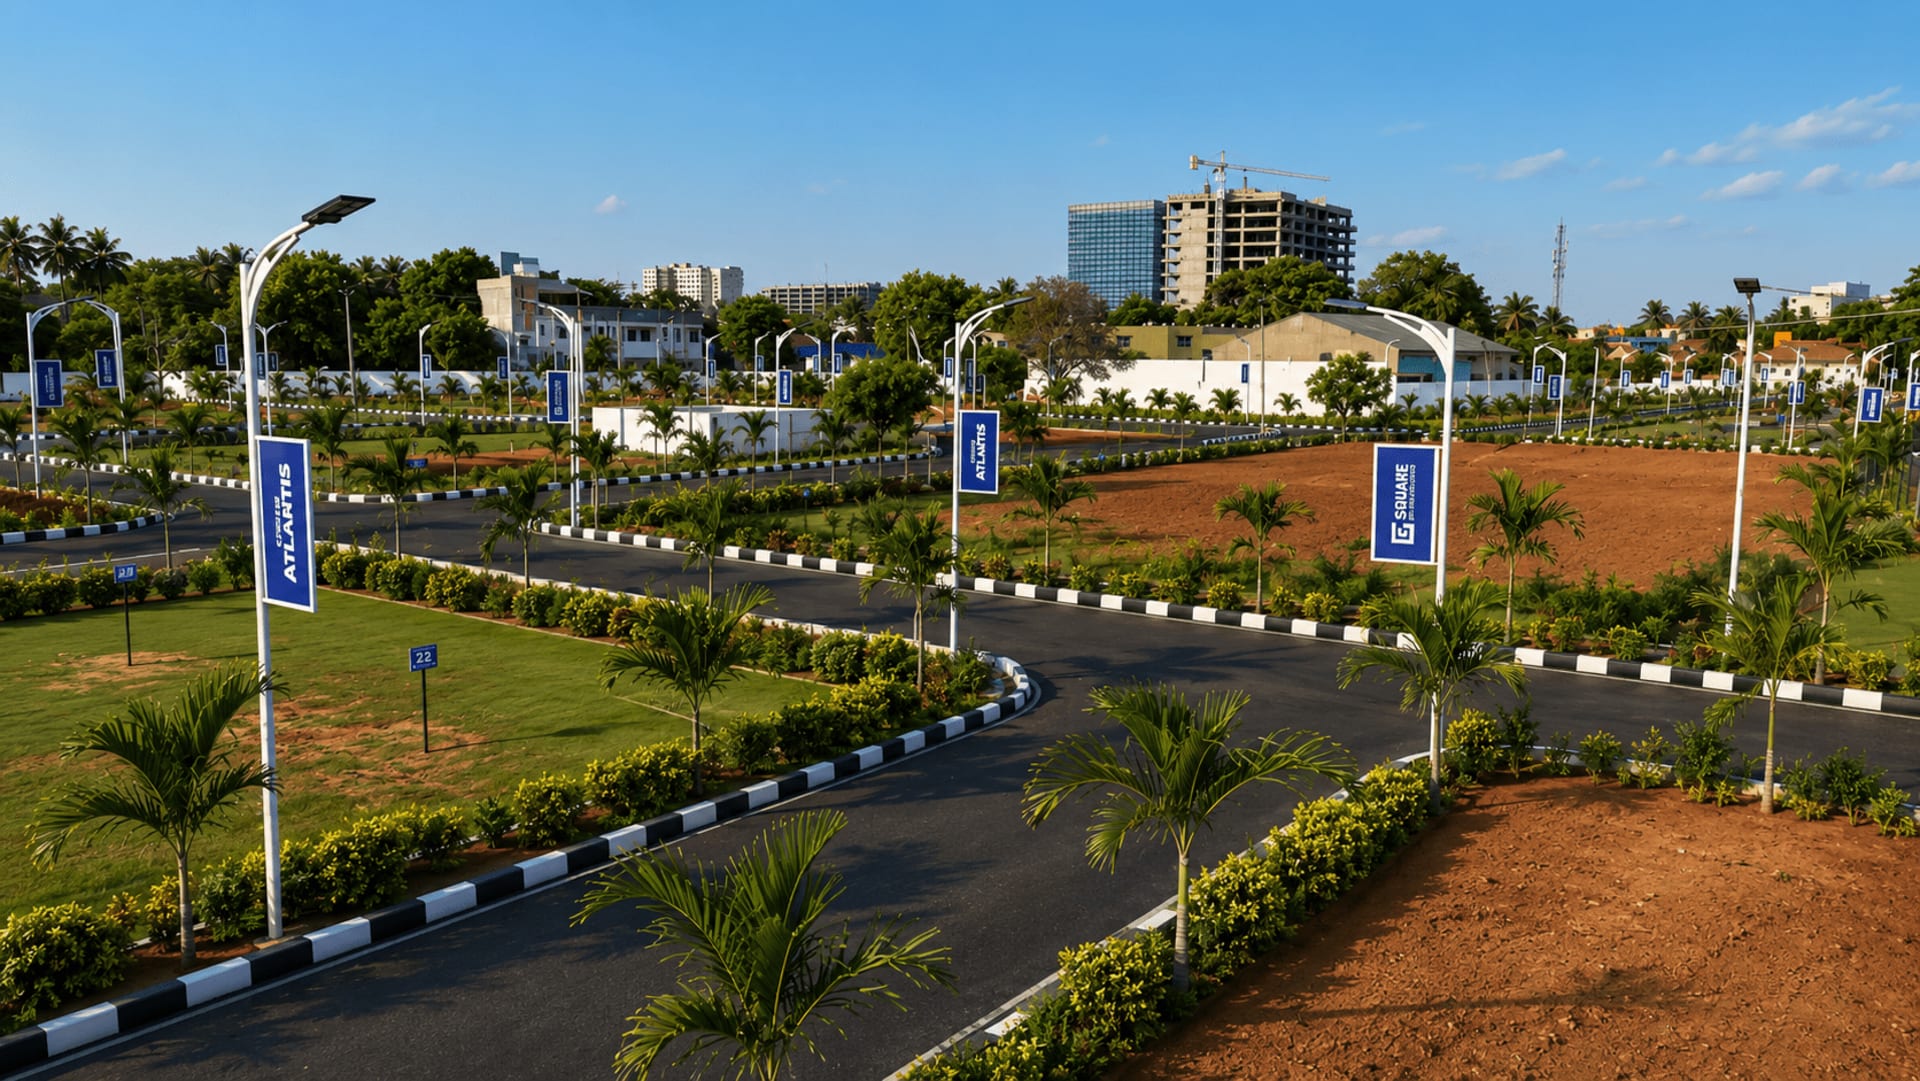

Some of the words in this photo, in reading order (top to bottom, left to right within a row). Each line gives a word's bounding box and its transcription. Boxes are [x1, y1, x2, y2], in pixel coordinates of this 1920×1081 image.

[976, 423, 986, 481] ATLANTIS
[278, 463, 297, 583] ATLANTIS
[416, 651, 432, 664] 22
